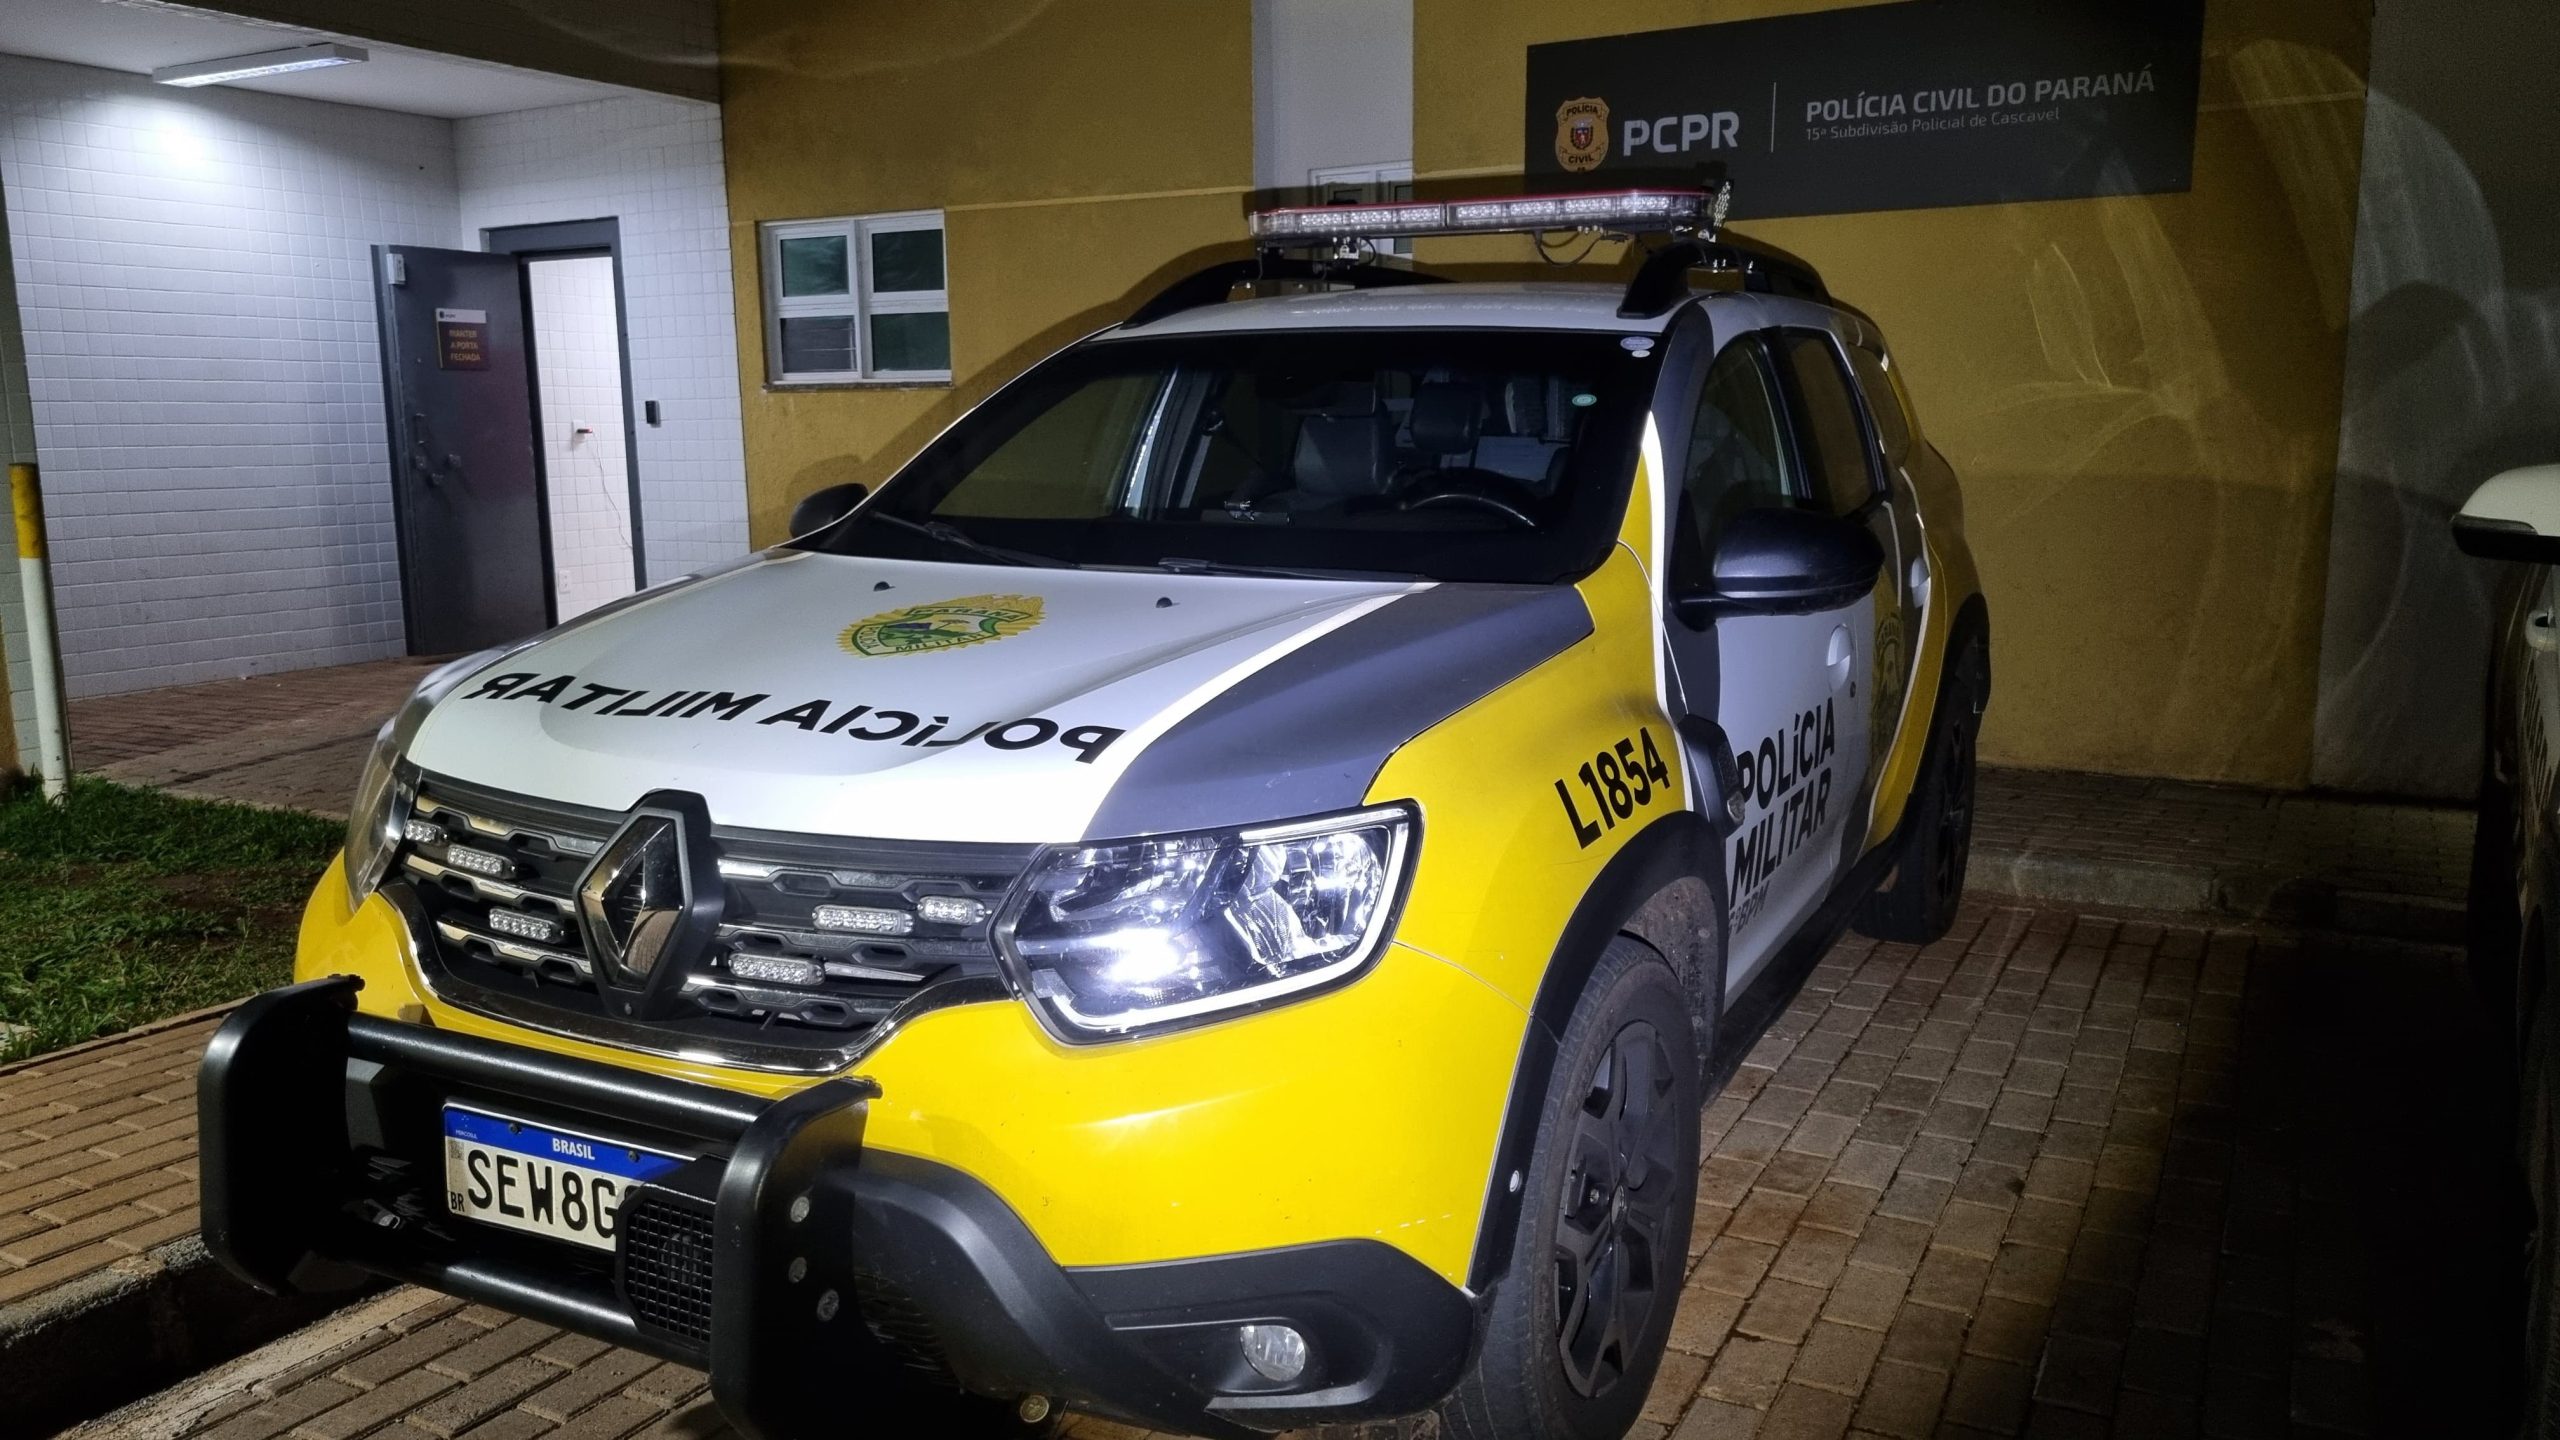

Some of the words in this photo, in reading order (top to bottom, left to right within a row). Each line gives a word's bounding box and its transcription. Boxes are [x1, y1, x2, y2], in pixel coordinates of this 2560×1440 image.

[1806, 91, 1907, 122] POLÍCIA
[1913, 88, 1980, 114] CIVIL
[1987, 82, 2026, 107] DO
[2035, 63, 2155, 103] PARANÁ
[1623, 111, 1740, 157] PCPR
[1830, 121, 1908, 140] Subdivisão
[1912, 115, 1966, 132] Policial
[1969, 114, 1987, 127] de
[1991, 106, 2060, 126] Cascavel
[1568, 153, 1595, 164] CIVIL
[896, 632, 986, 652] MILITAR
[1736, 697, 1836, 810] POLÍCIA
[1554, 726, 1671, 850] L1854
[1730, 767, 1832, 911] MILITAR
[552, 1137, 596, 1160] BRASIL
[450, 1191, 466, 1213] BR
[467, 1149, 638, 1239] SEW8G
